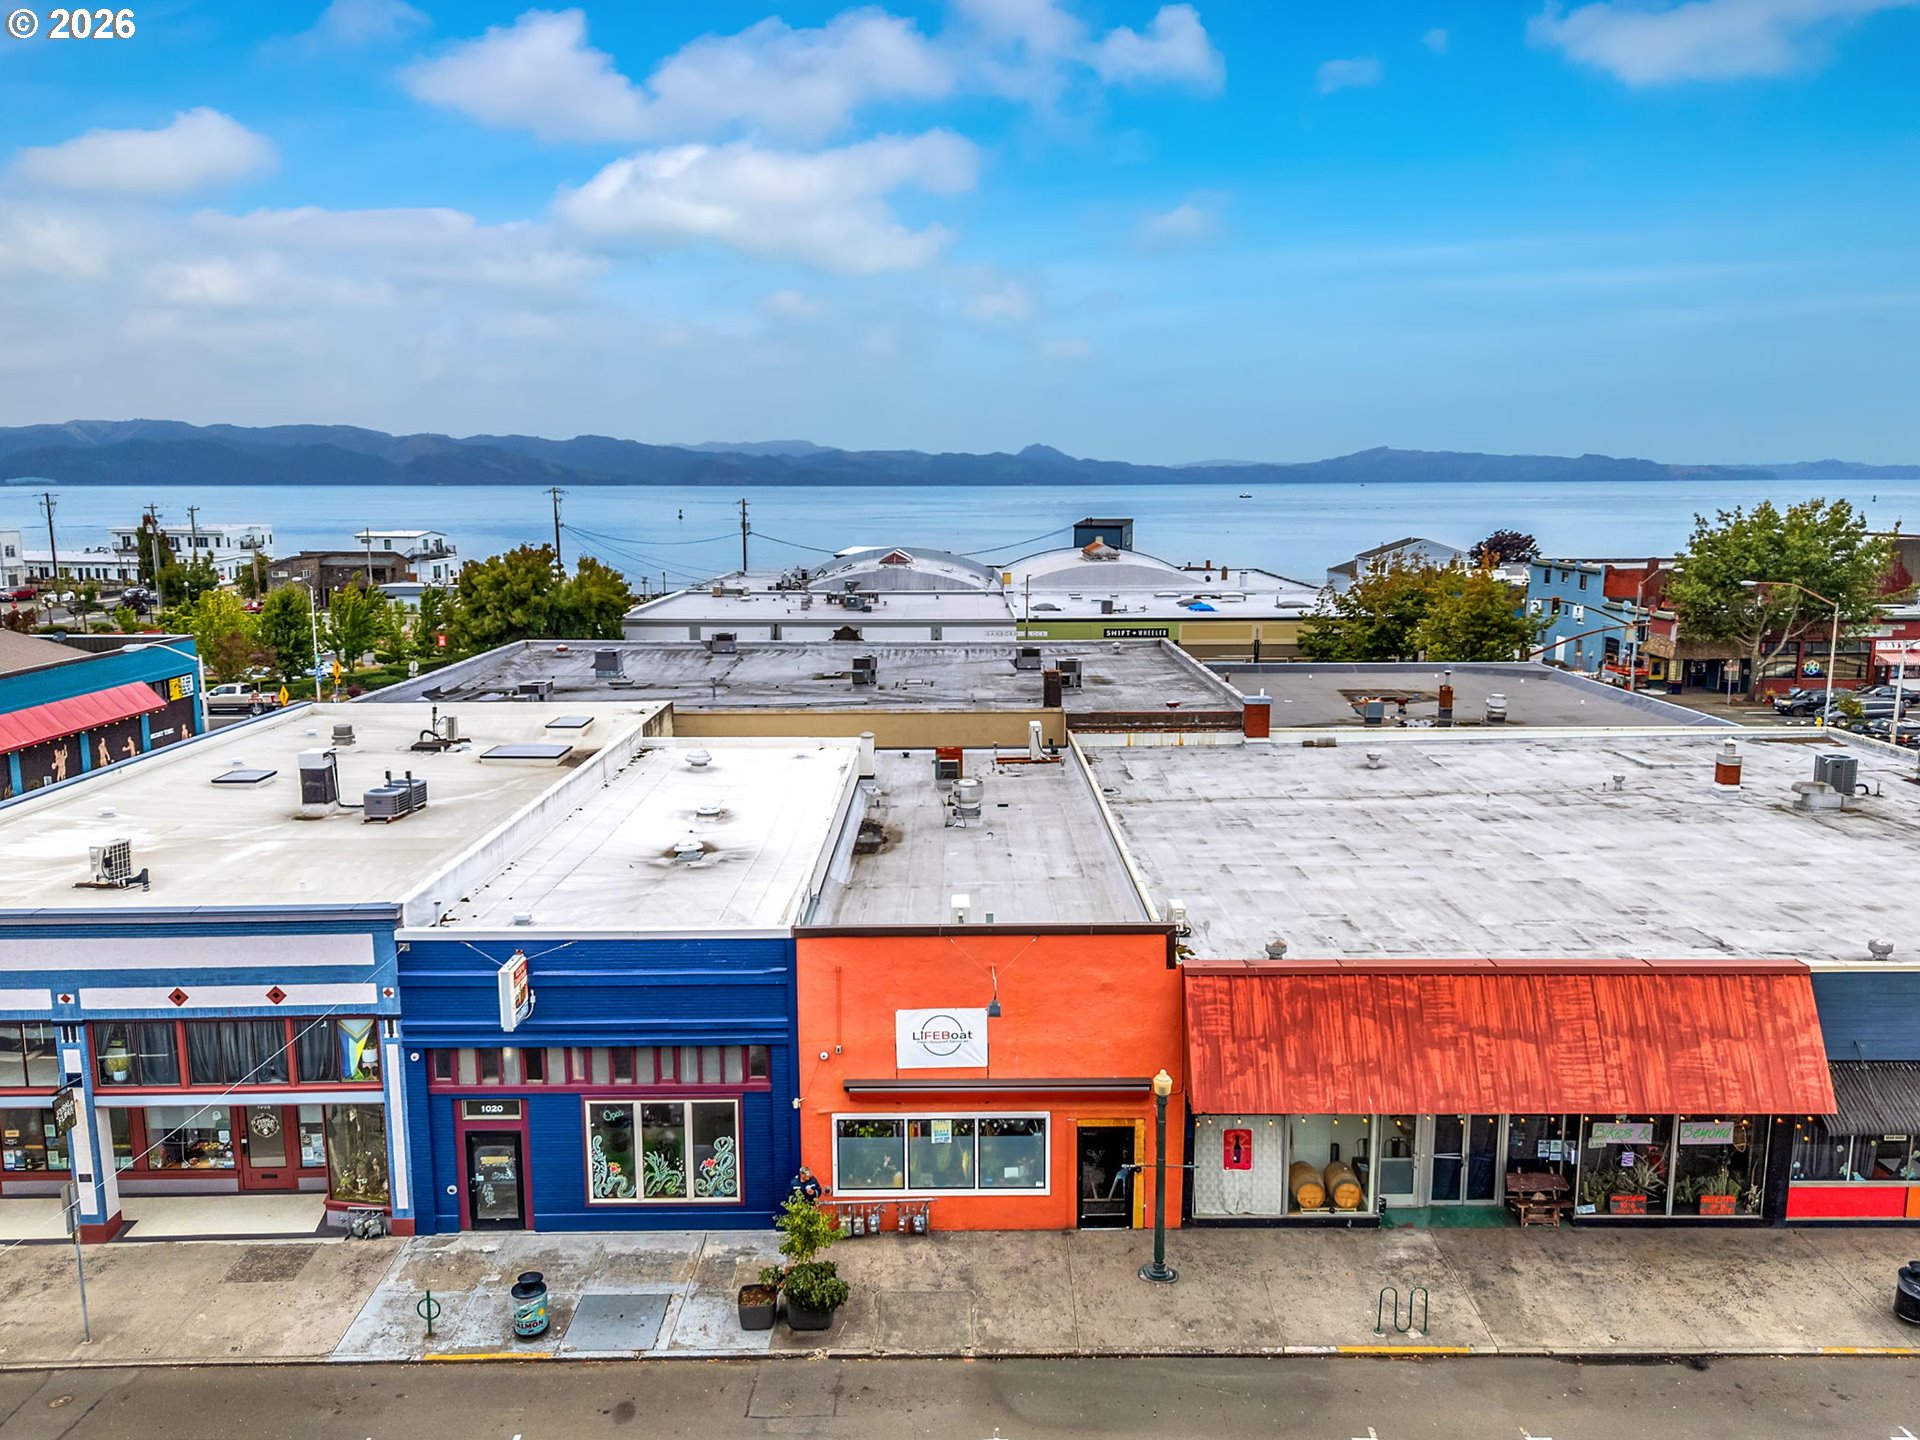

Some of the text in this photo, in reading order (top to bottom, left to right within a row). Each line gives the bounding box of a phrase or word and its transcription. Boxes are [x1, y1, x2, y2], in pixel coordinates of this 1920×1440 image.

[1106, 629, 1131, 637] SHIFT
[1138, 629, 1167, 637] WHEELER
[481, 1105, 504, 1113] 1020
[603, 1110, 625, 1121] Open
[1681, 1124, 1732, 1142] Beyond
[514, 1319, 544, 1329] ALMON
